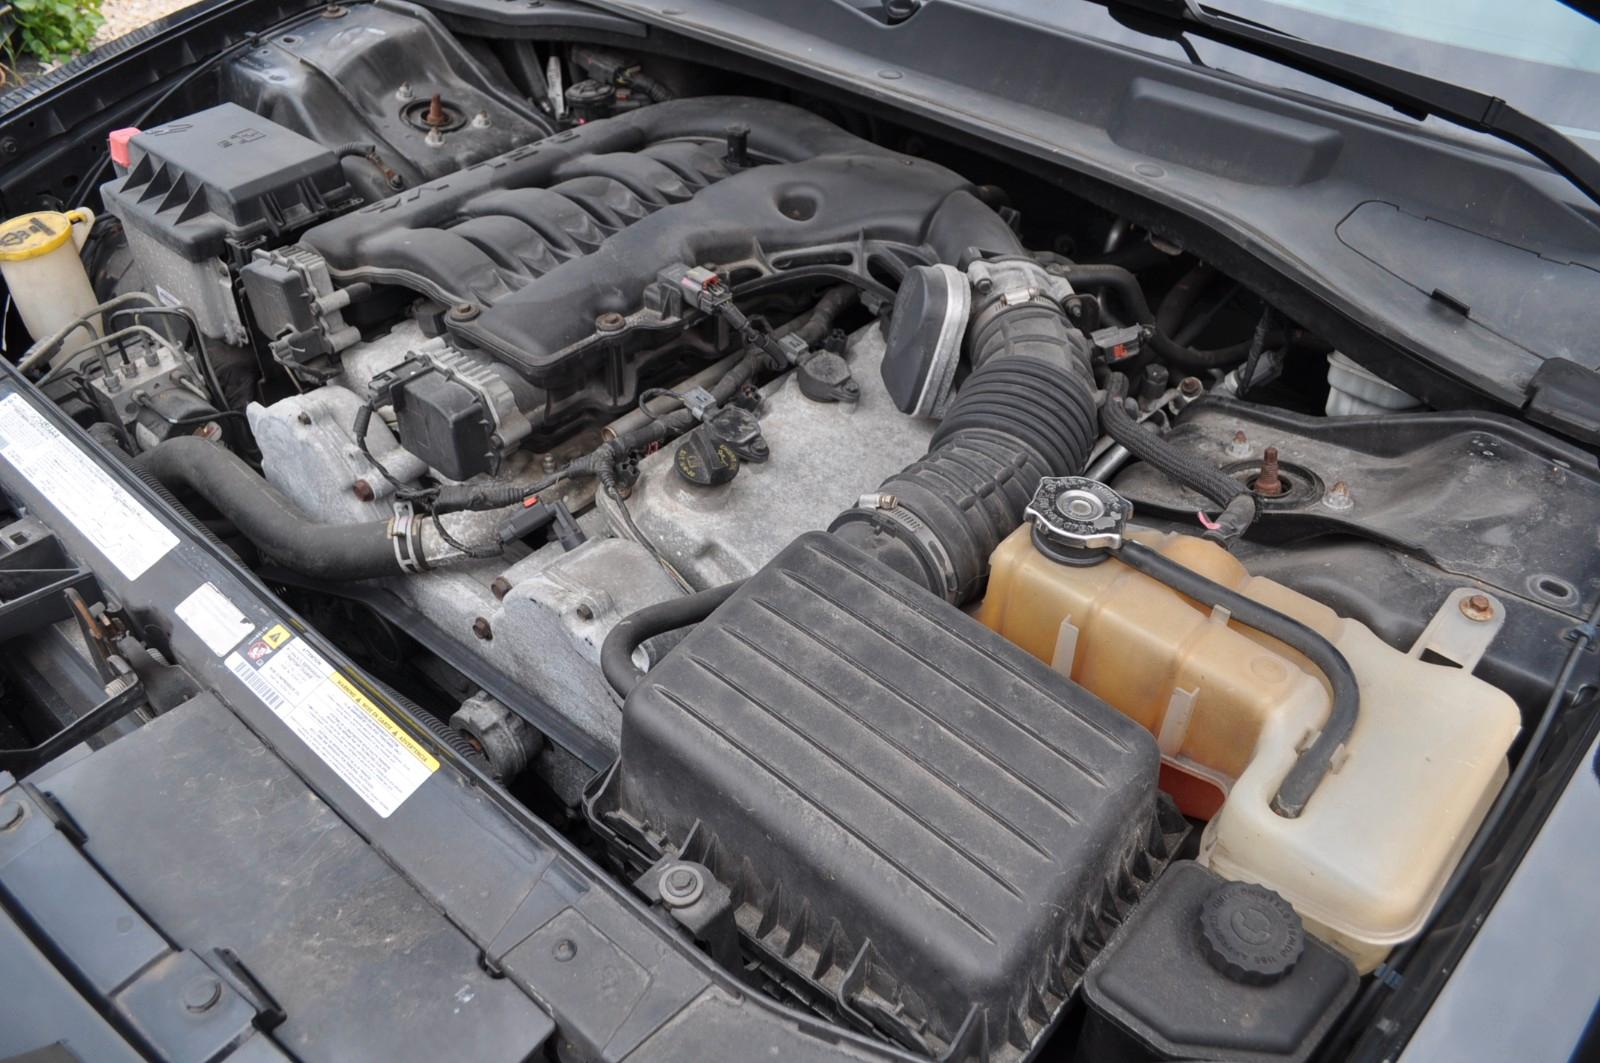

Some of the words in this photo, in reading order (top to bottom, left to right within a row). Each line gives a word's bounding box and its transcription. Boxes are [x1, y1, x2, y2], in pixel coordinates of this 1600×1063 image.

[336, 679, 356, 698] WARNING
[376, 715, 392, 730] GARDE
[398, 734, 428, 762] ADVERTENCIA
